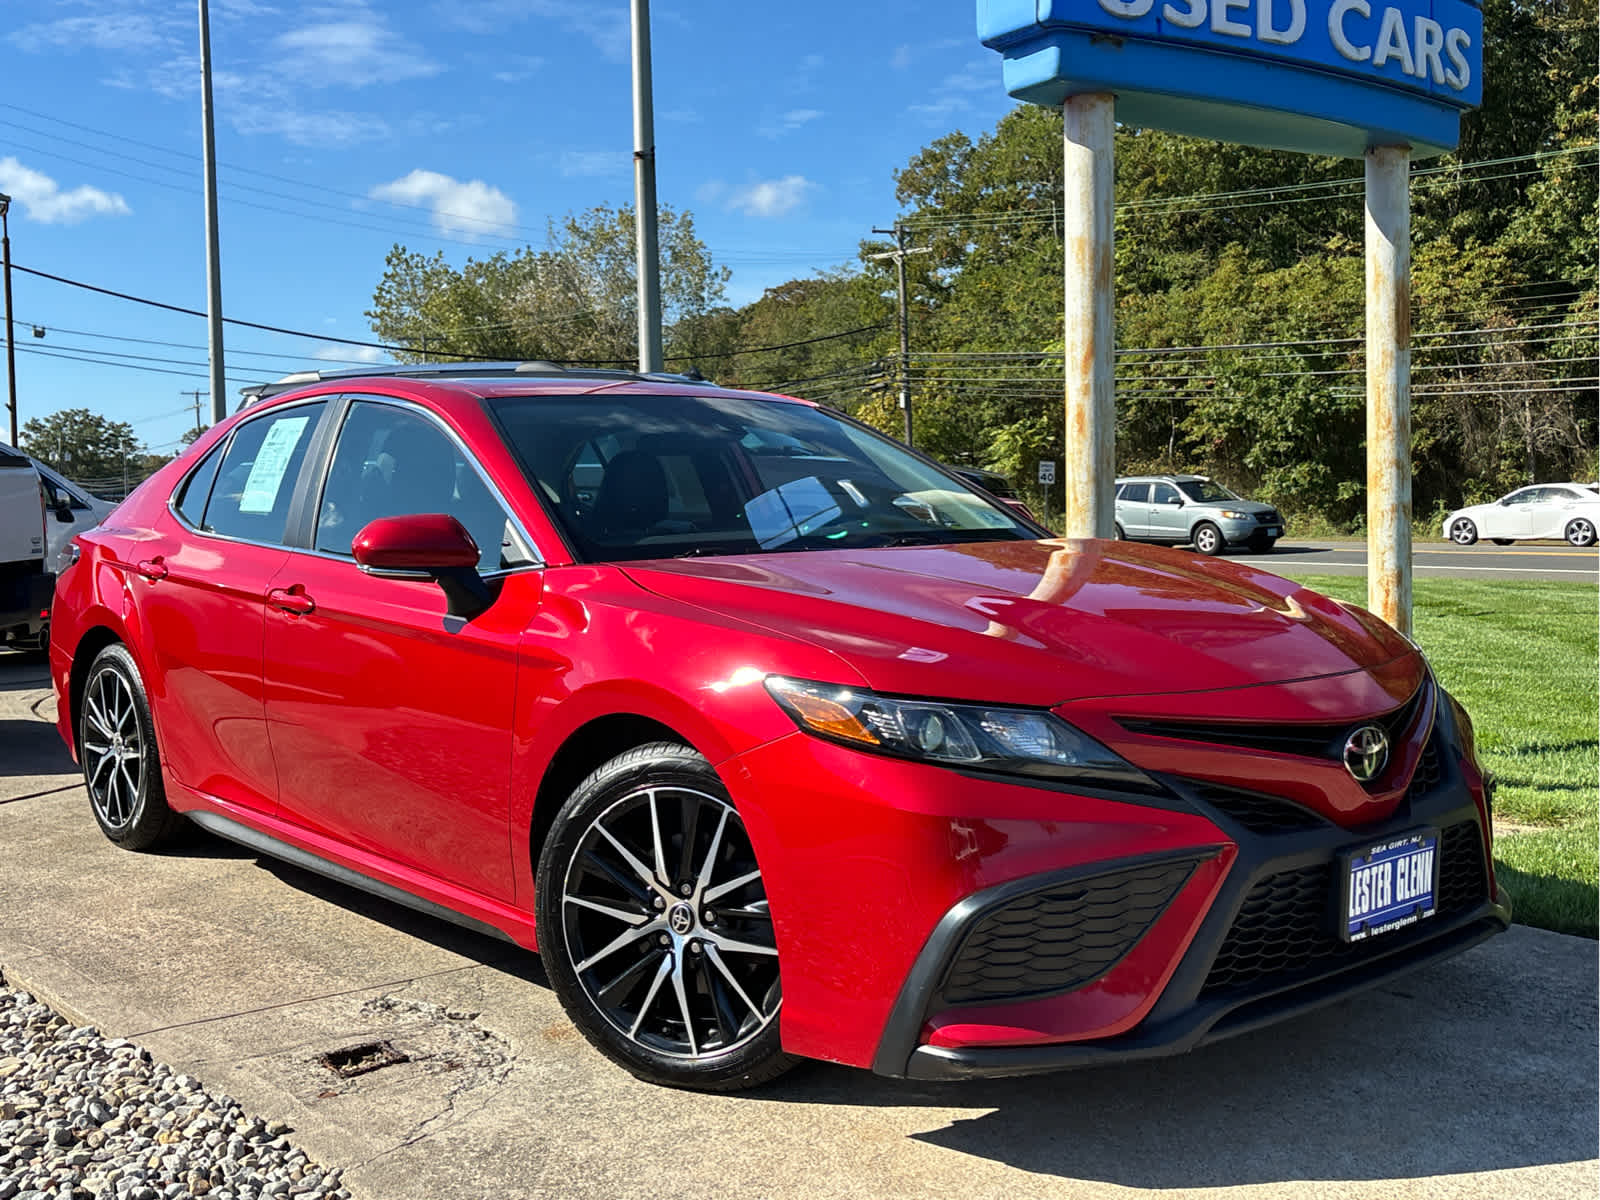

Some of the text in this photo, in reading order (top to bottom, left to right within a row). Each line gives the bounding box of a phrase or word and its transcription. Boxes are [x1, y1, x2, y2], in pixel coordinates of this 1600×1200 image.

[1327, 0, 1471, 90] CARS
[1040, 473, 1053, 482] 40
[1371, 845, 1386, 854] SEA
[1411, 835, 1422, 843] NJ
[1349, 850, 1433, 918] LESTER GLENN
